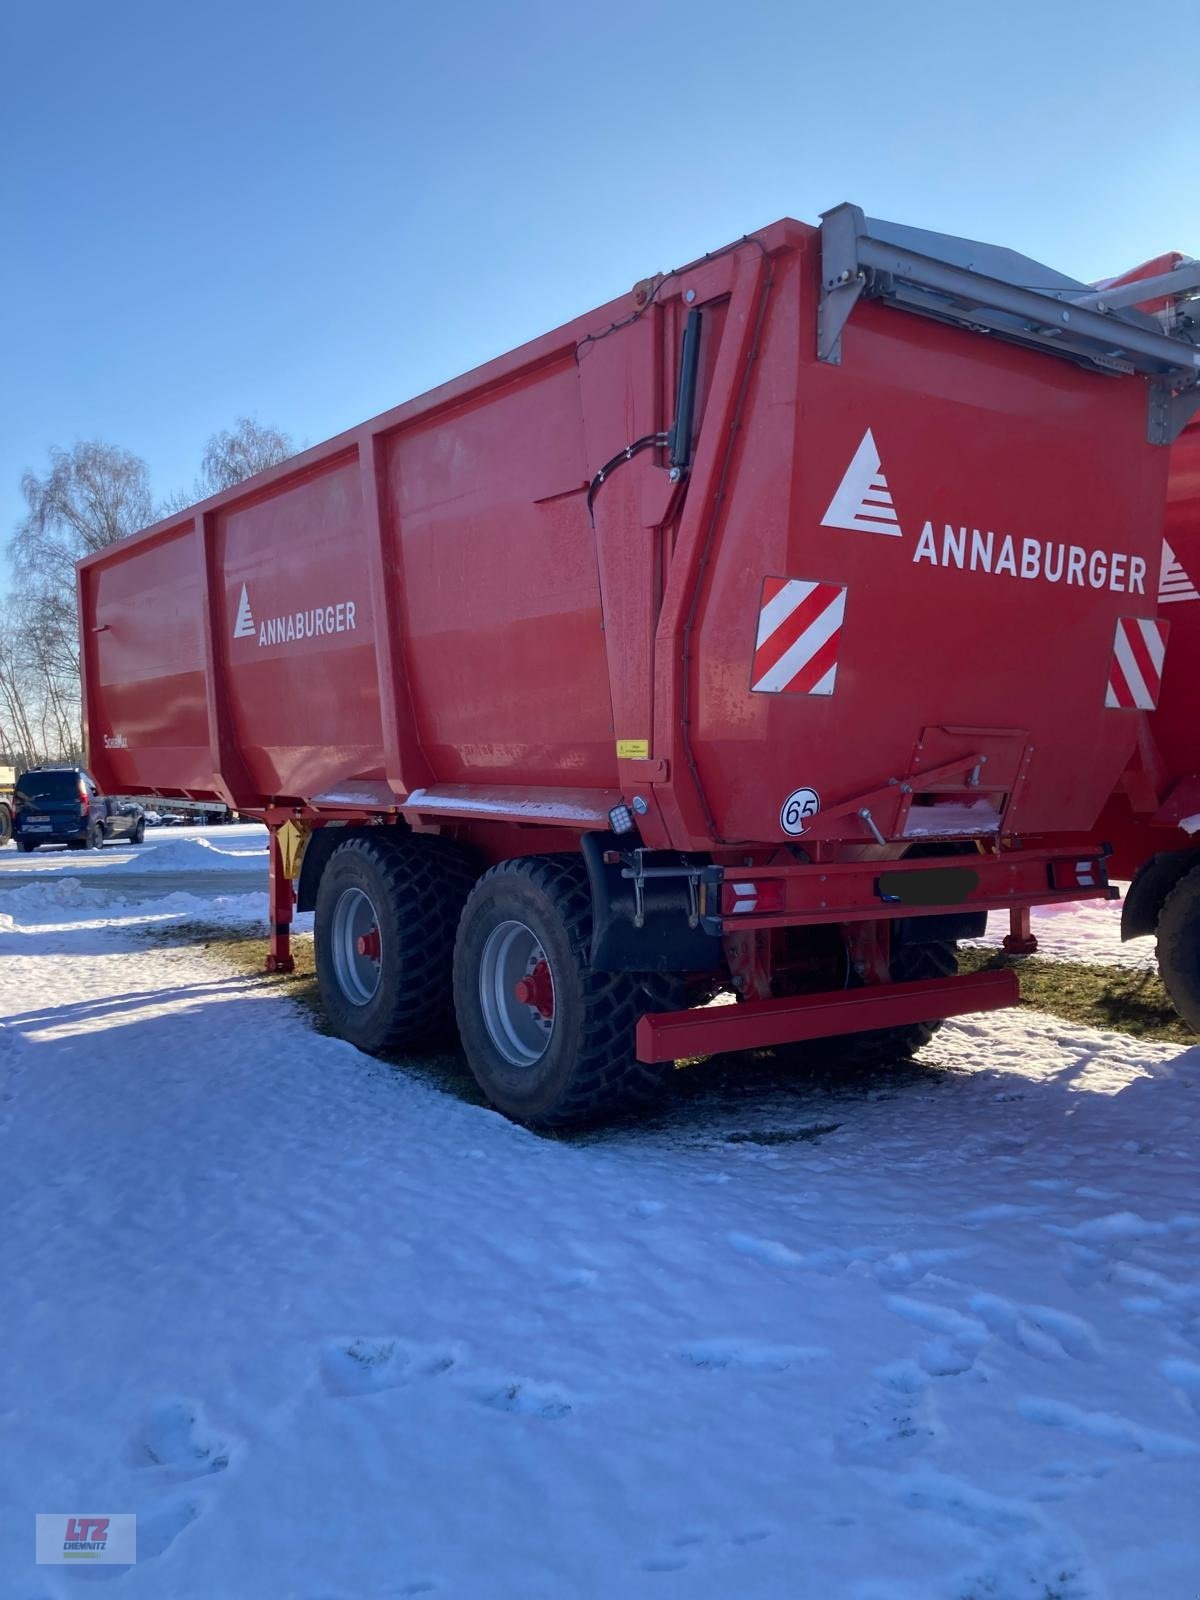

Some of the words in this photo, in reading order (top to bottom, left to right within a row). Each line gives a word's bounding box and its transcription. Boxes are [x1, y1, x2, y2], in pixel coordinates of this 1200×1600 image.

[913, 521, 1147, 594] ANNABURGER
[258, 602, 356, 646] ANNABURGER
[786, 800, 816, 825] 65
